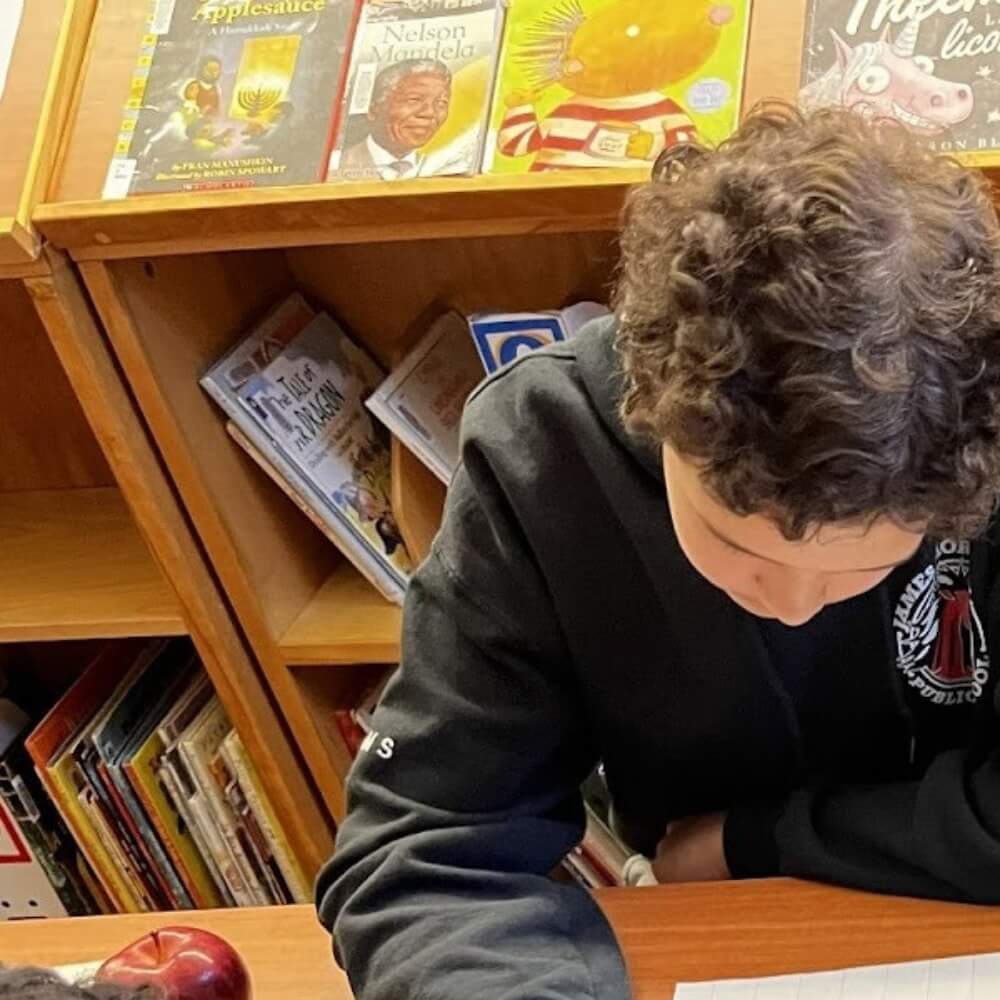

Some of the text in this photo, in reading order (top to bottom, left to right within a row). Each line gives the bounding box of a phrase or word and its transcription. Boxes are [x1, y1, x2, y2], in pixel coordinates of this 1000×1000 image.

[381, 22, 466, 44] Nelson
[371, 40, 475, 62] Mandela
[908, 675, 977, 705] PUBLIC
